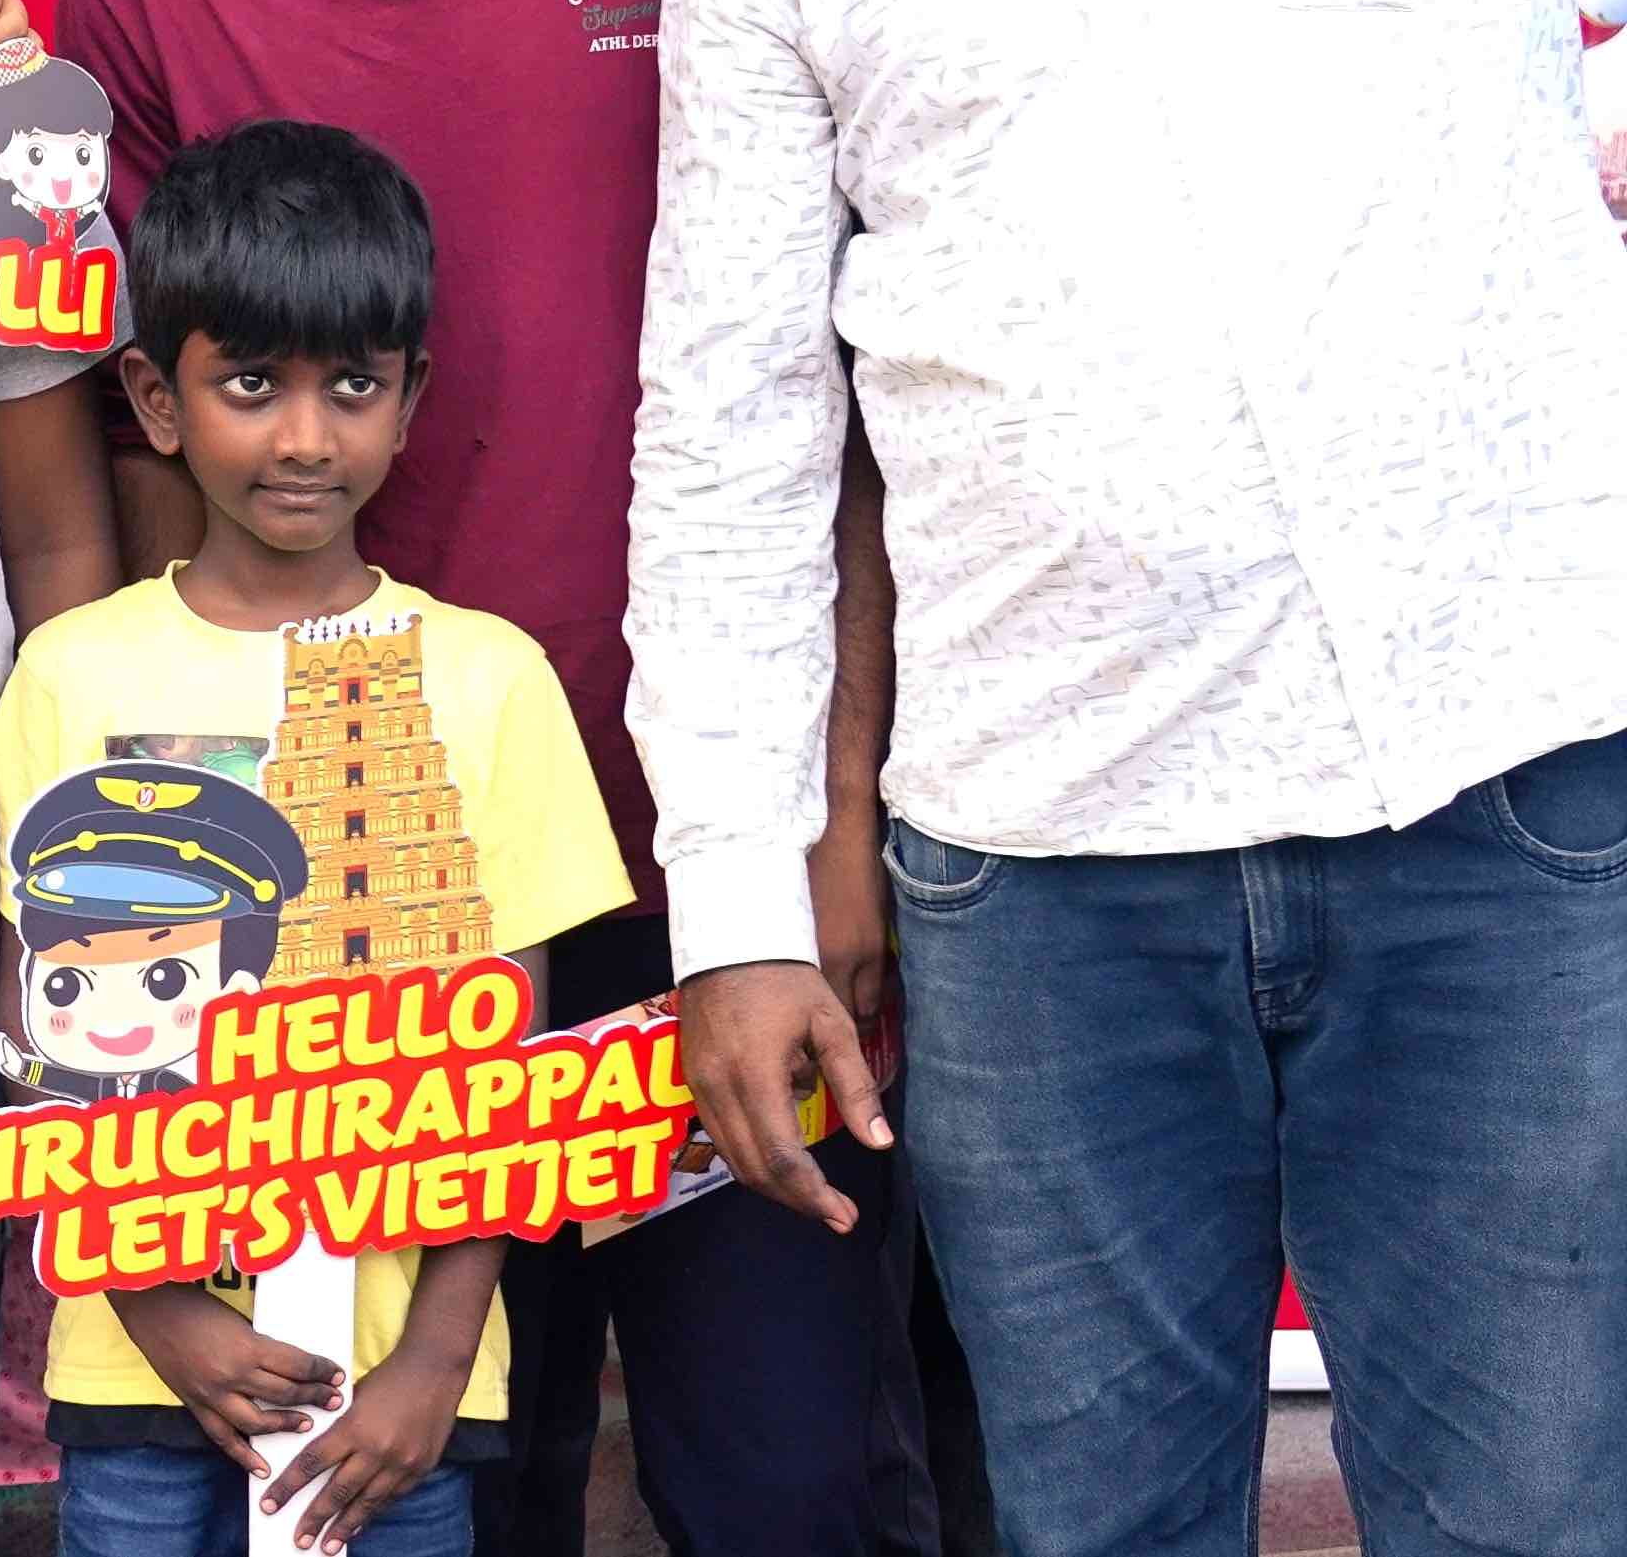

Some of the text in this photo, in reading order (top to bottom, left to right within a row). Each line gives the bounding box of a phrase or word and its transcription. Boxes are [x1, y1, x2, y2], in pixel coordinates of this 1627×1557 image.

[588, 35, 630, 53] ATHL
[211, 973, 519, 1085] HELLO
[54, 1177, 296, 1283] LET'S
[314, 1118, 673, 1245] VIETJET
